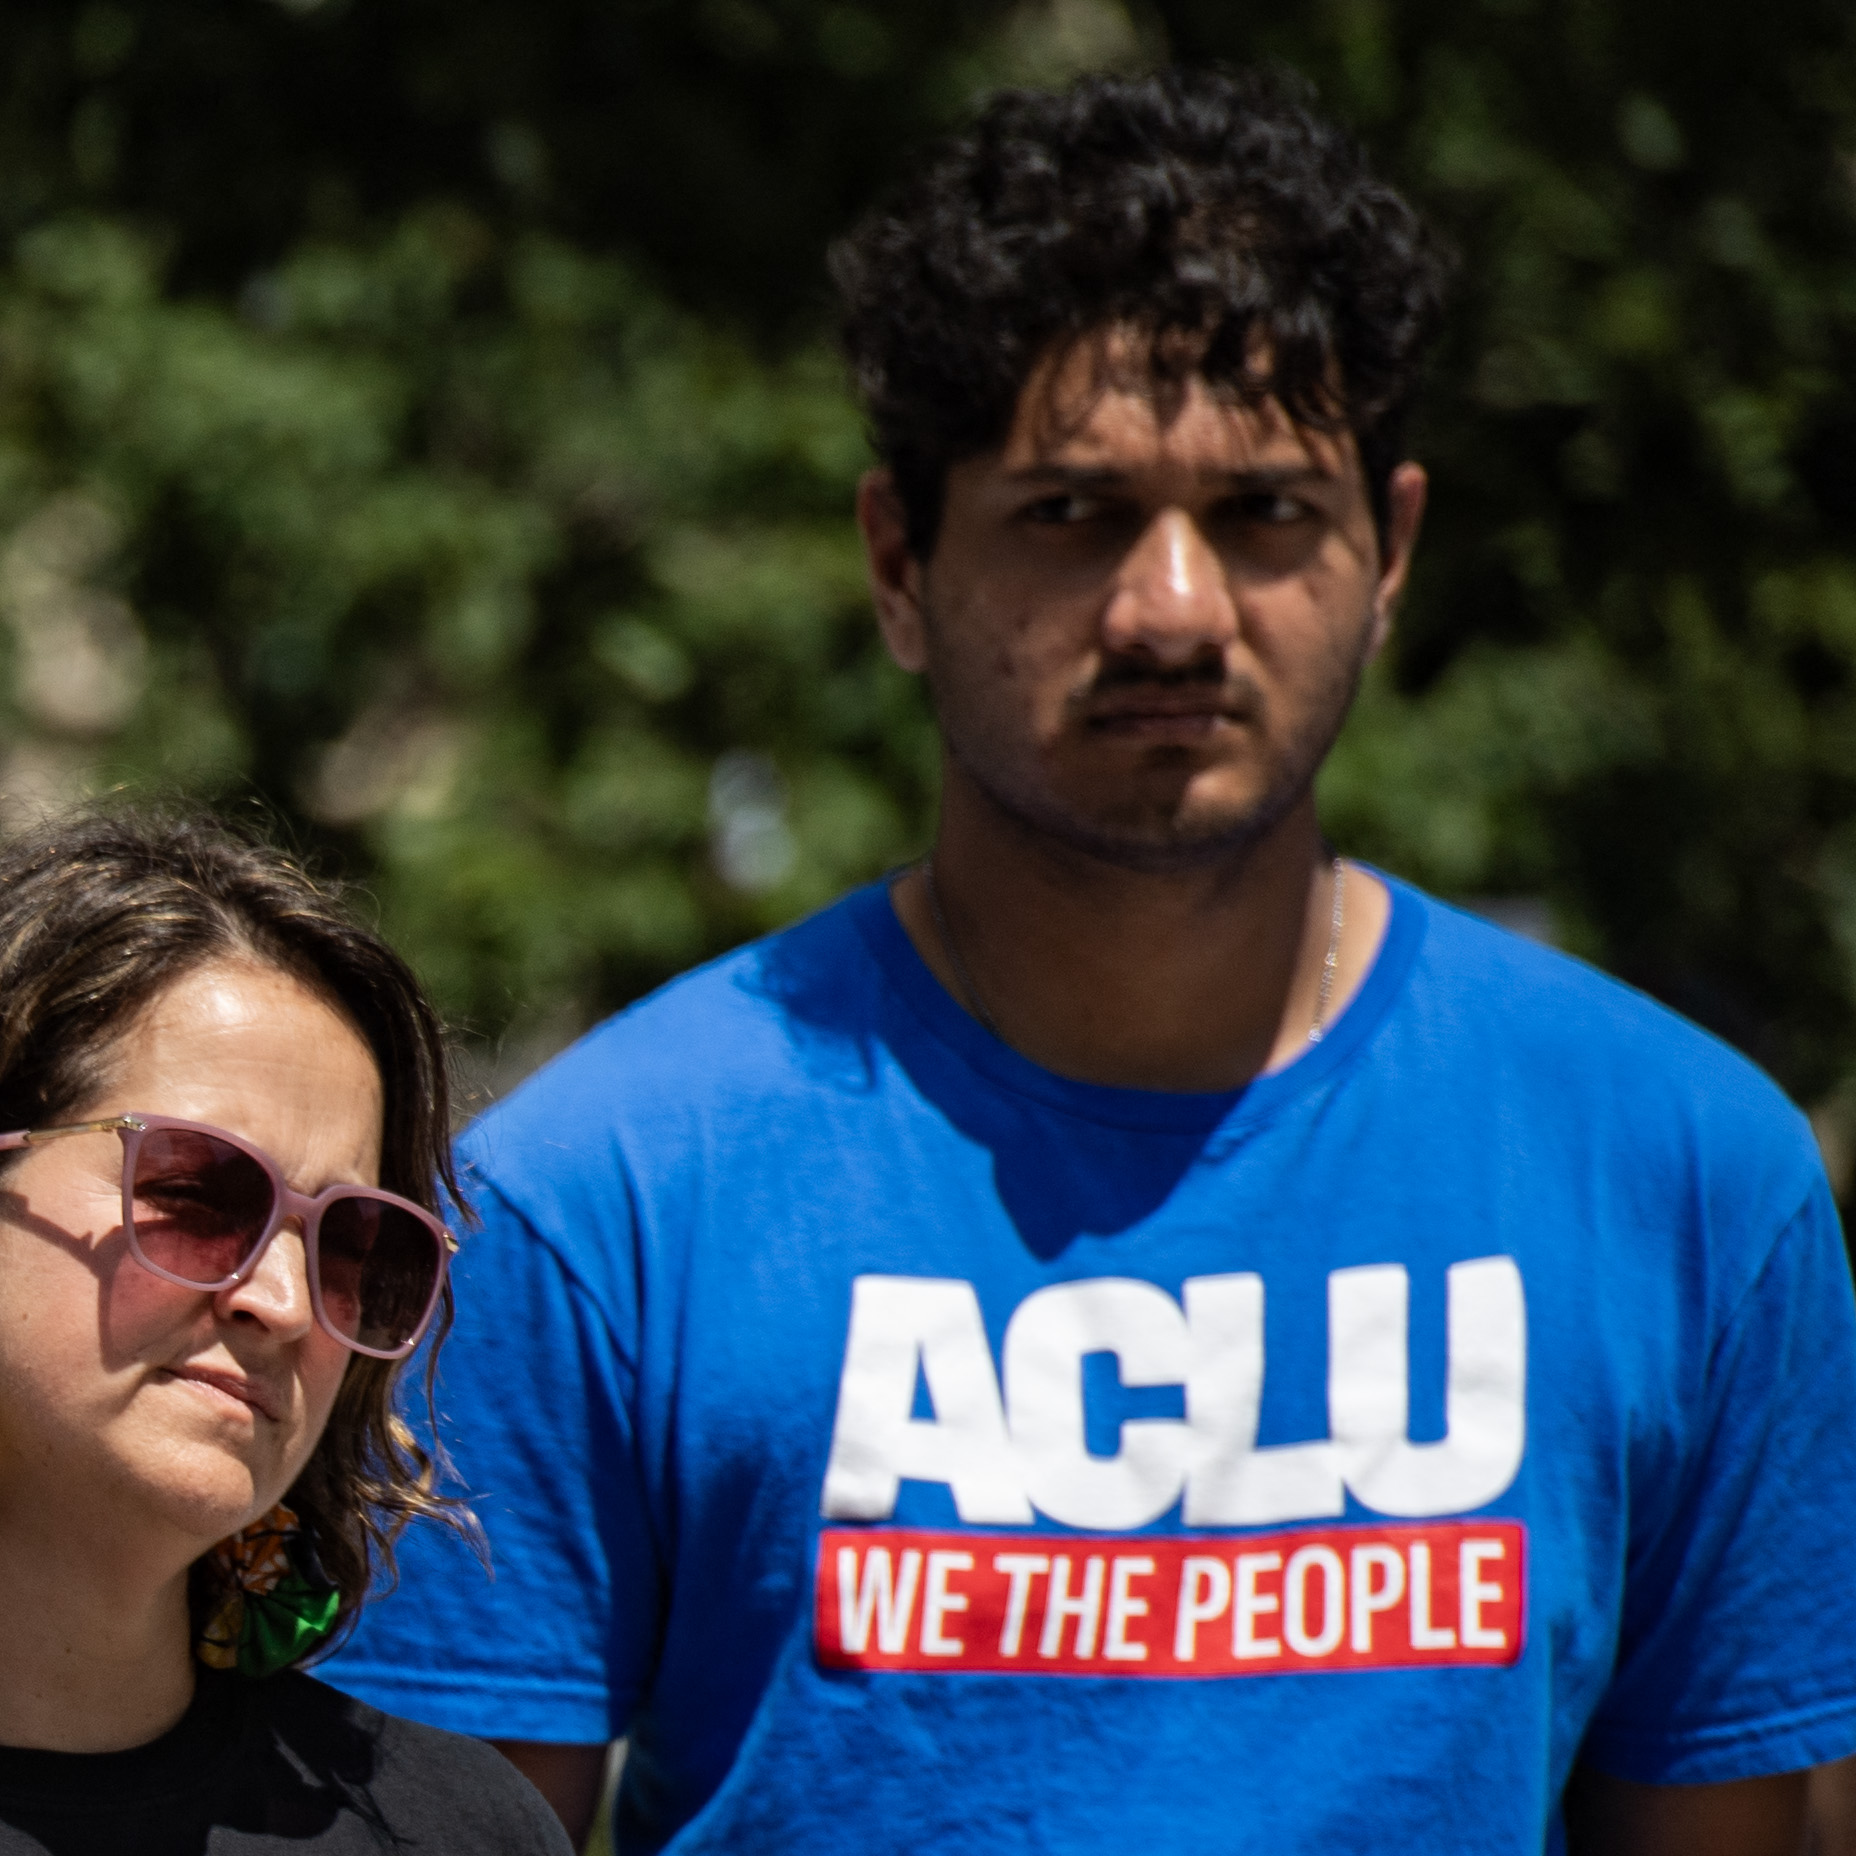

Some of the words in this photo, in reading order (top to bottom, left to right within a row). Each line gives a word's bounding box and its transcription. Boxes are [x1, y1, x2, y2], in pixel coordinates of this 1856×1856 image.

[819, 1255, 1527, 1531] ACLU
[836, 1546, 975, 1658] WE
[993, 1554, 1155, 1660] THE
[1173, 1537, 1507, 1662] PEOPLE
